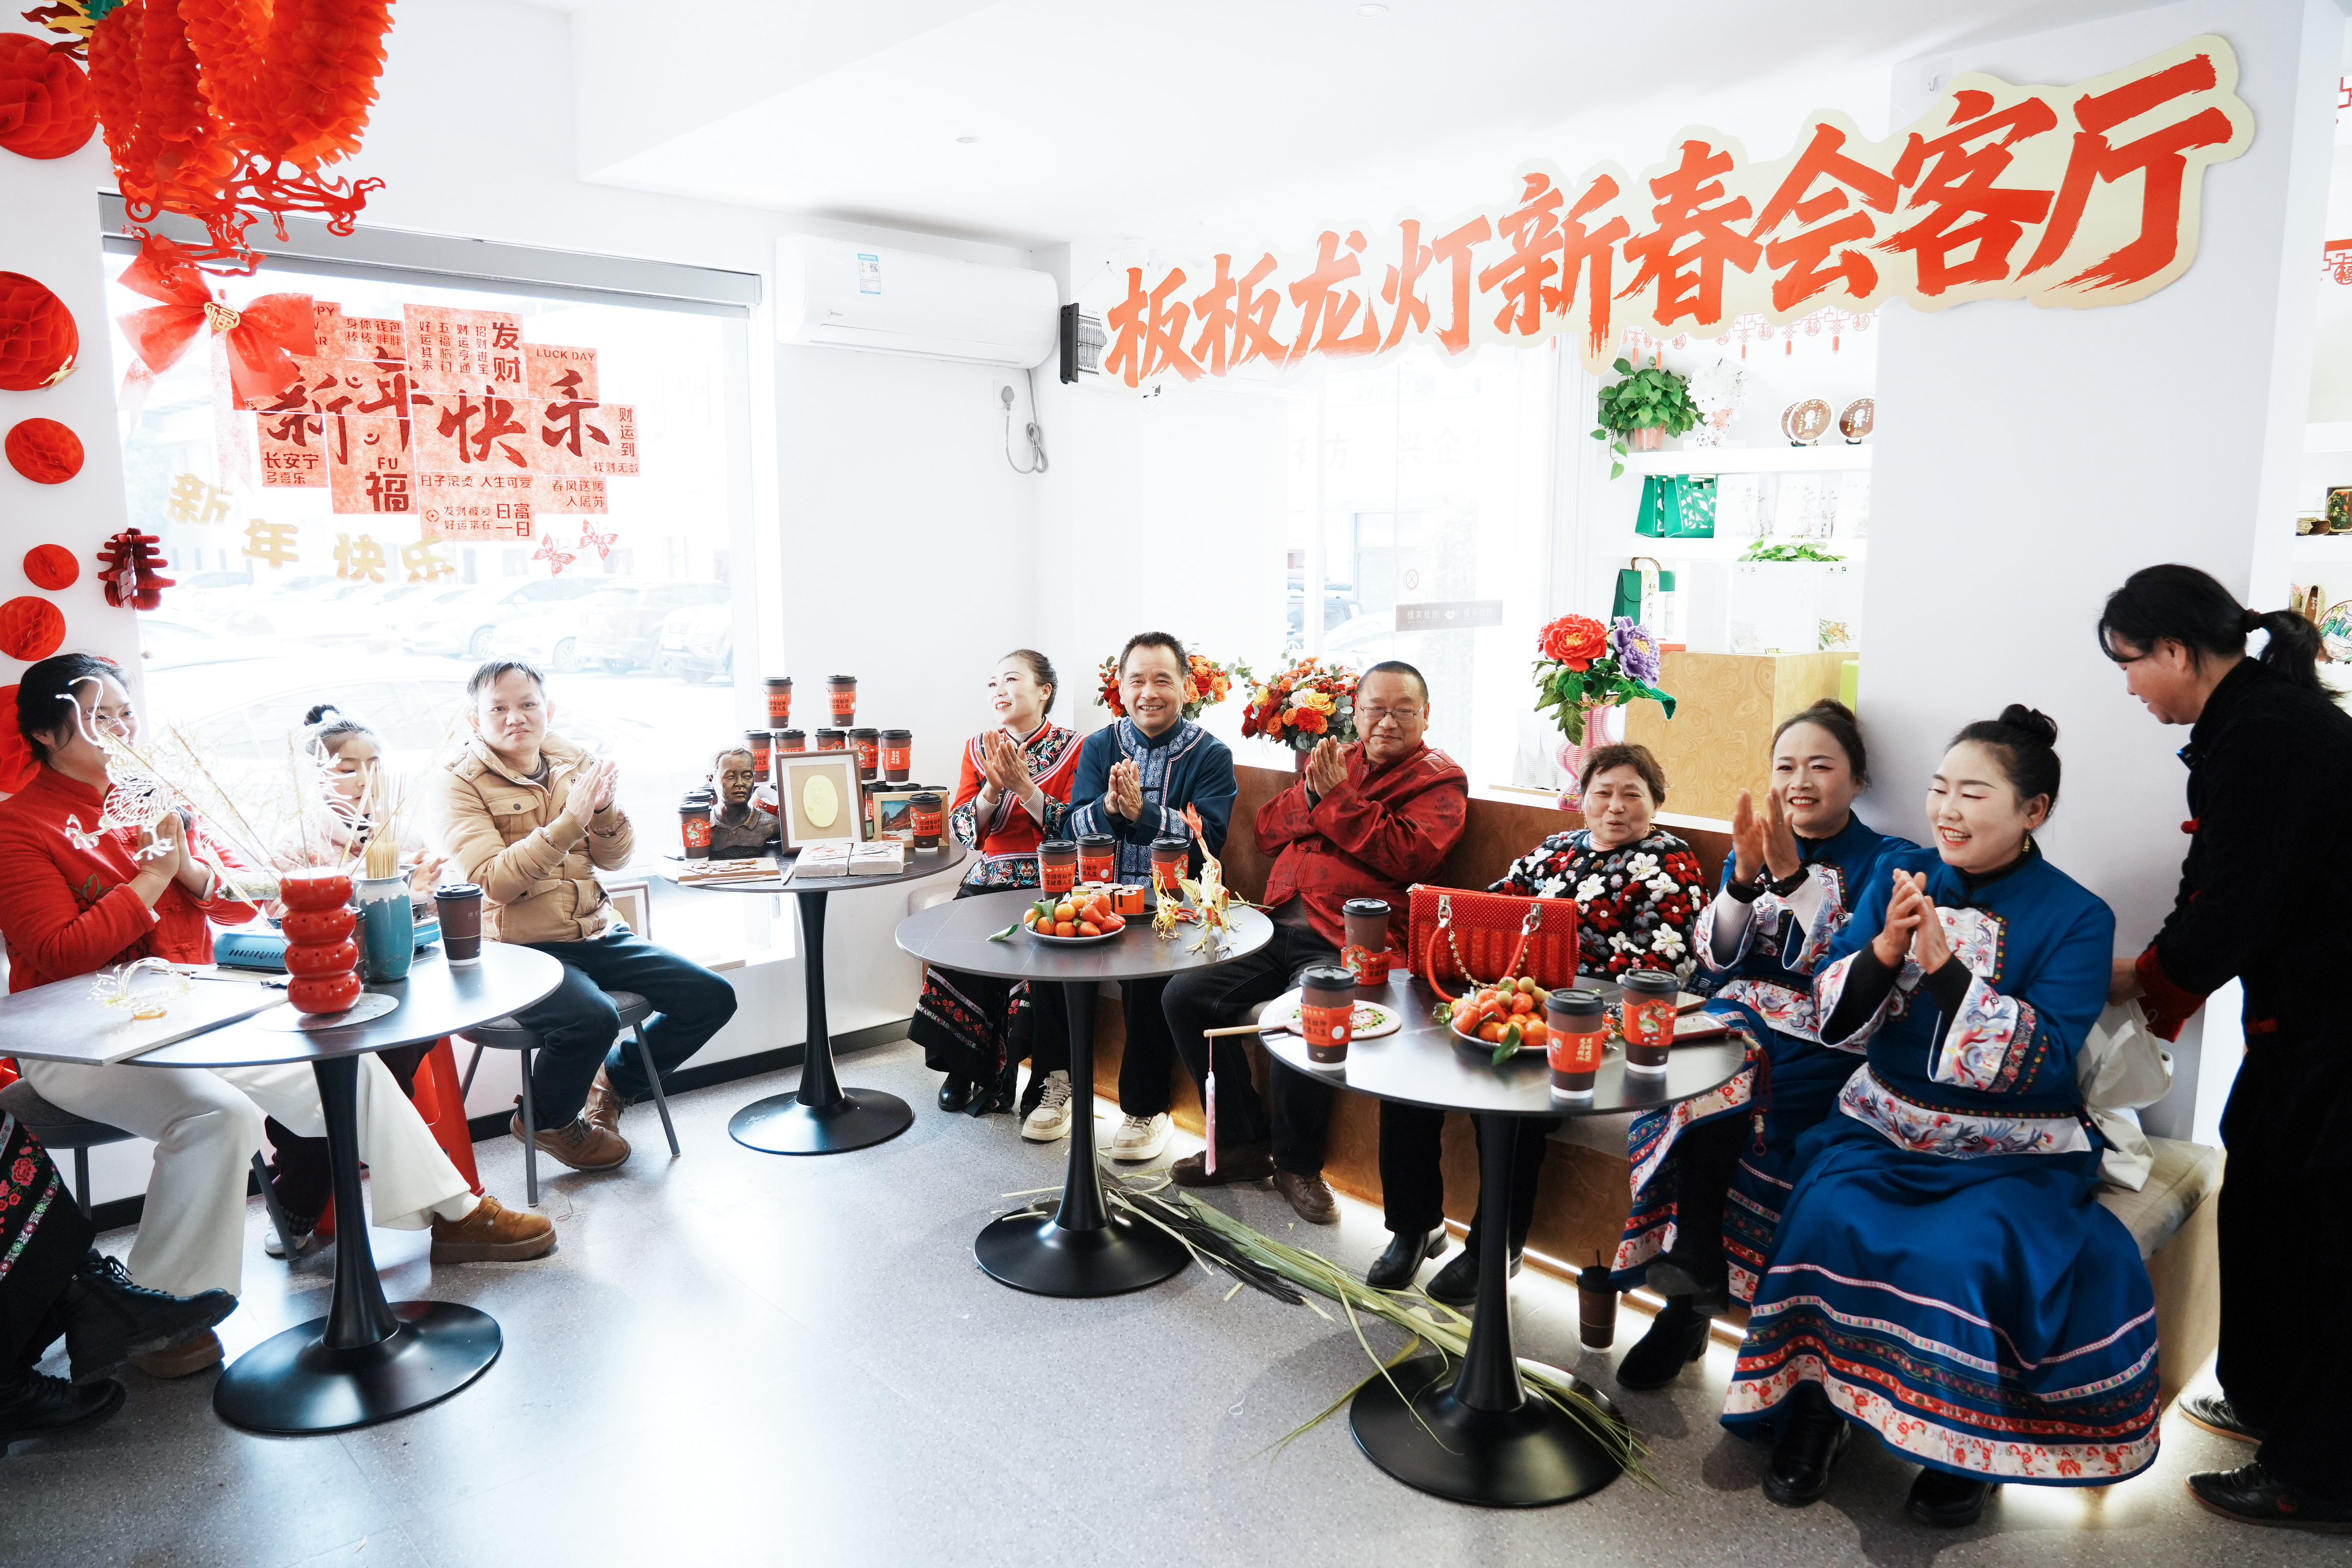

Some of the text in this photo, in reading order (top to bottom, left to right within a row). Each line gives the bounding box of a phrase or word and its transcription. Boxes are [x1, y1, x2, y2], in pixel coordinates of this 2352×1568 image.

[1104, 54, 2235, 389] 板板龙灯新春会客厅
[347, 318, 400, 333] 身体钱包
[347, 331, 401, 346] 棒棒胖胖
[420, 321, 433, 371] 好运其来
[438, 322, 452, 372] 五福临门
[457, 324, 470, 374] 财运亨通
[476, 325, 489, 374] 招财进宝
[492, 322, 521, 383] 发财
[536, 348, 595, 361] LUCK DAY
[619, 408, 634, 457] 财运到
[264, 451, 319, 469] 长安宁
[378, 457, 398, 470] FU
[594, 462, 639, 473] 钱财无数
[266, 471, 306, 484] 多喜乐
[421, 475, 531, 488] 日子滚烫 人生可爱
[365, 472, 409, 512] 福
[552, 480, 604, 492] 春风送暖
[567, 496, 604, 507] 入屠苏
[444, 506, 491, 516] 发财被爱
[165, 472, 456, 584] 新年快乐
[445, 520, 492, 530] 好运常在
[1407, 609, 1438, 620] 情有杜仲
[1464, 607, 1492, 617] 情有杜仲
